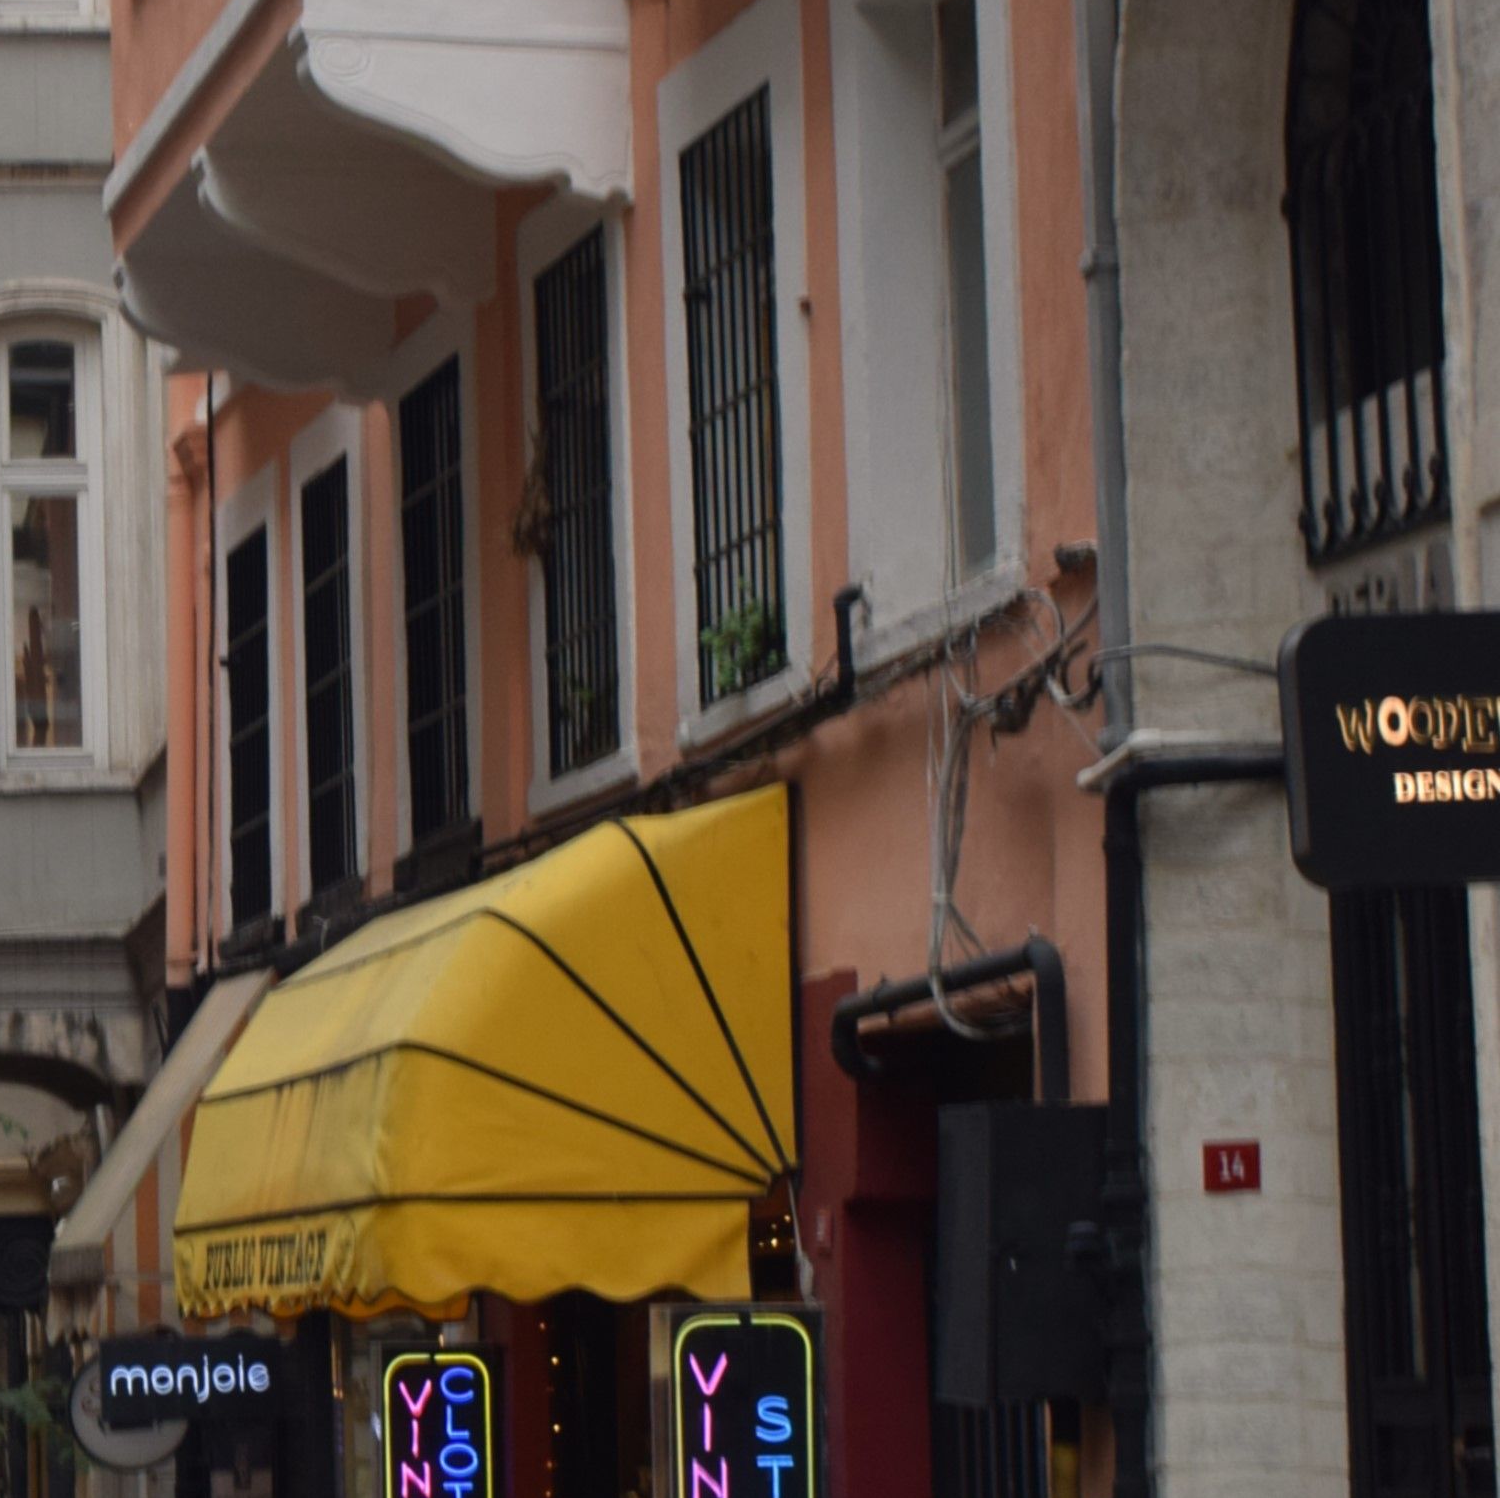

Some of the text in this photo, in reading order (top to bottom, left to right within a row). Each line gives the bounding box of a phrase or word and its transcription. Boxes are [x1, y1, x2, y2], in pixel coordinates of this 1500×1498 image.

[1335, 693, 1500, 756] WOODE
[1219, 1150, 1245, 1182] 14
[203, 1227, 328, 1291] PUBLIC VINTAGE
[110, 1352, 270, 1404] monjoie
